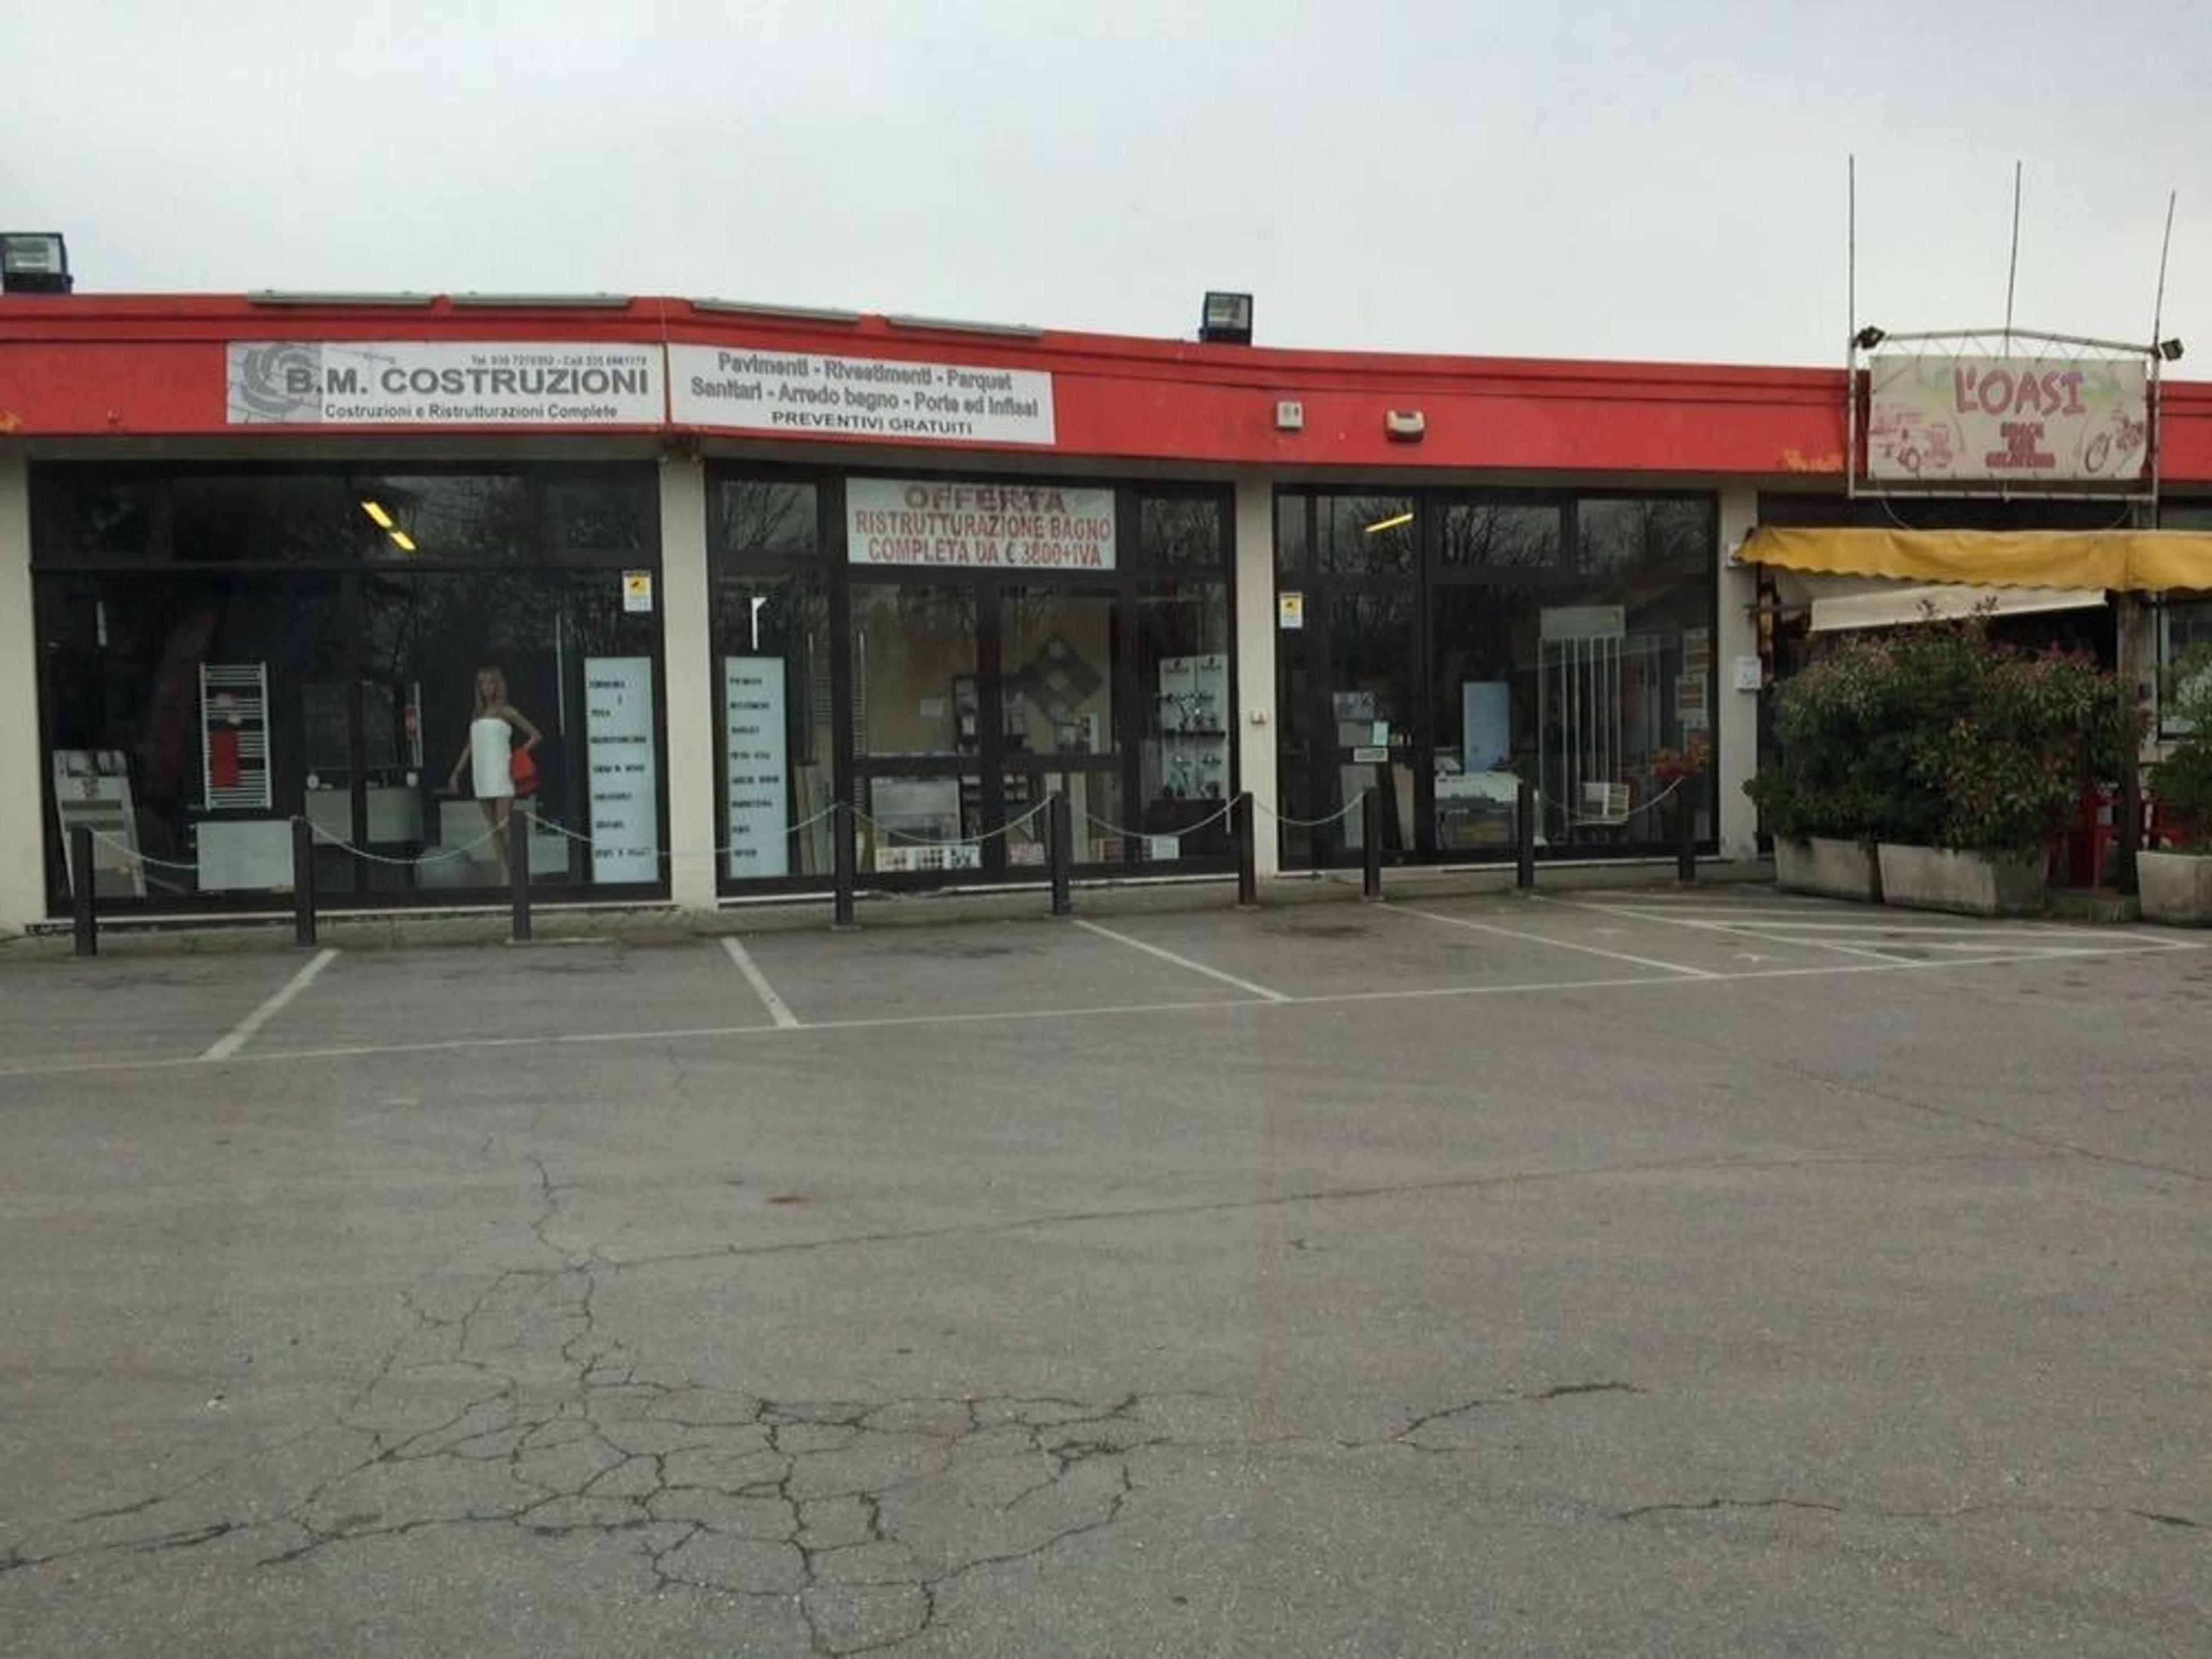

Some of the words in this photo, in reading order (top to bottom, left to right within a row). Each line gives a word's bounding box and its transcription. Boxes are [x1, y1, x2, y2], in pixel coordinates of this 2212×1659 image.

[381, 368, 648, 395] COSTRUZIONI
[718, 352, 809, 377] Pavimenti
[824, 359, 932, 386] Rivestimenti
[946, 369, 1012, 392] Parquet
[691, 376, 762, 400] Sanitari
[778, 382, 840, 404] Arredo
[844, 387, 899, 411] bagno
[914, 392, 959, 412] Porte
[963, 396, 984, 415] ed
[1955, 368, 2085, 416] L'OASI
[325, 404, 411, 418] Costruzioni
[416, 407, 424, 418] e
[429, 404, 544, 419] Ristrutturazioni
[548, 404, 618, 419] Complete
[771, 411, 883, 429] PREVENTIVI
[888, 418, 972, 435] GRATUITI
[904, 485, 1066, 514] OFFERTA
[855, 509, 1045, 539] RISTRUTTURAZIONE
[1050, 517, 1111, 540] BAGNO
[869, 537, 971, 562] COMPLETA
[975, 540, 998, 564] DA
